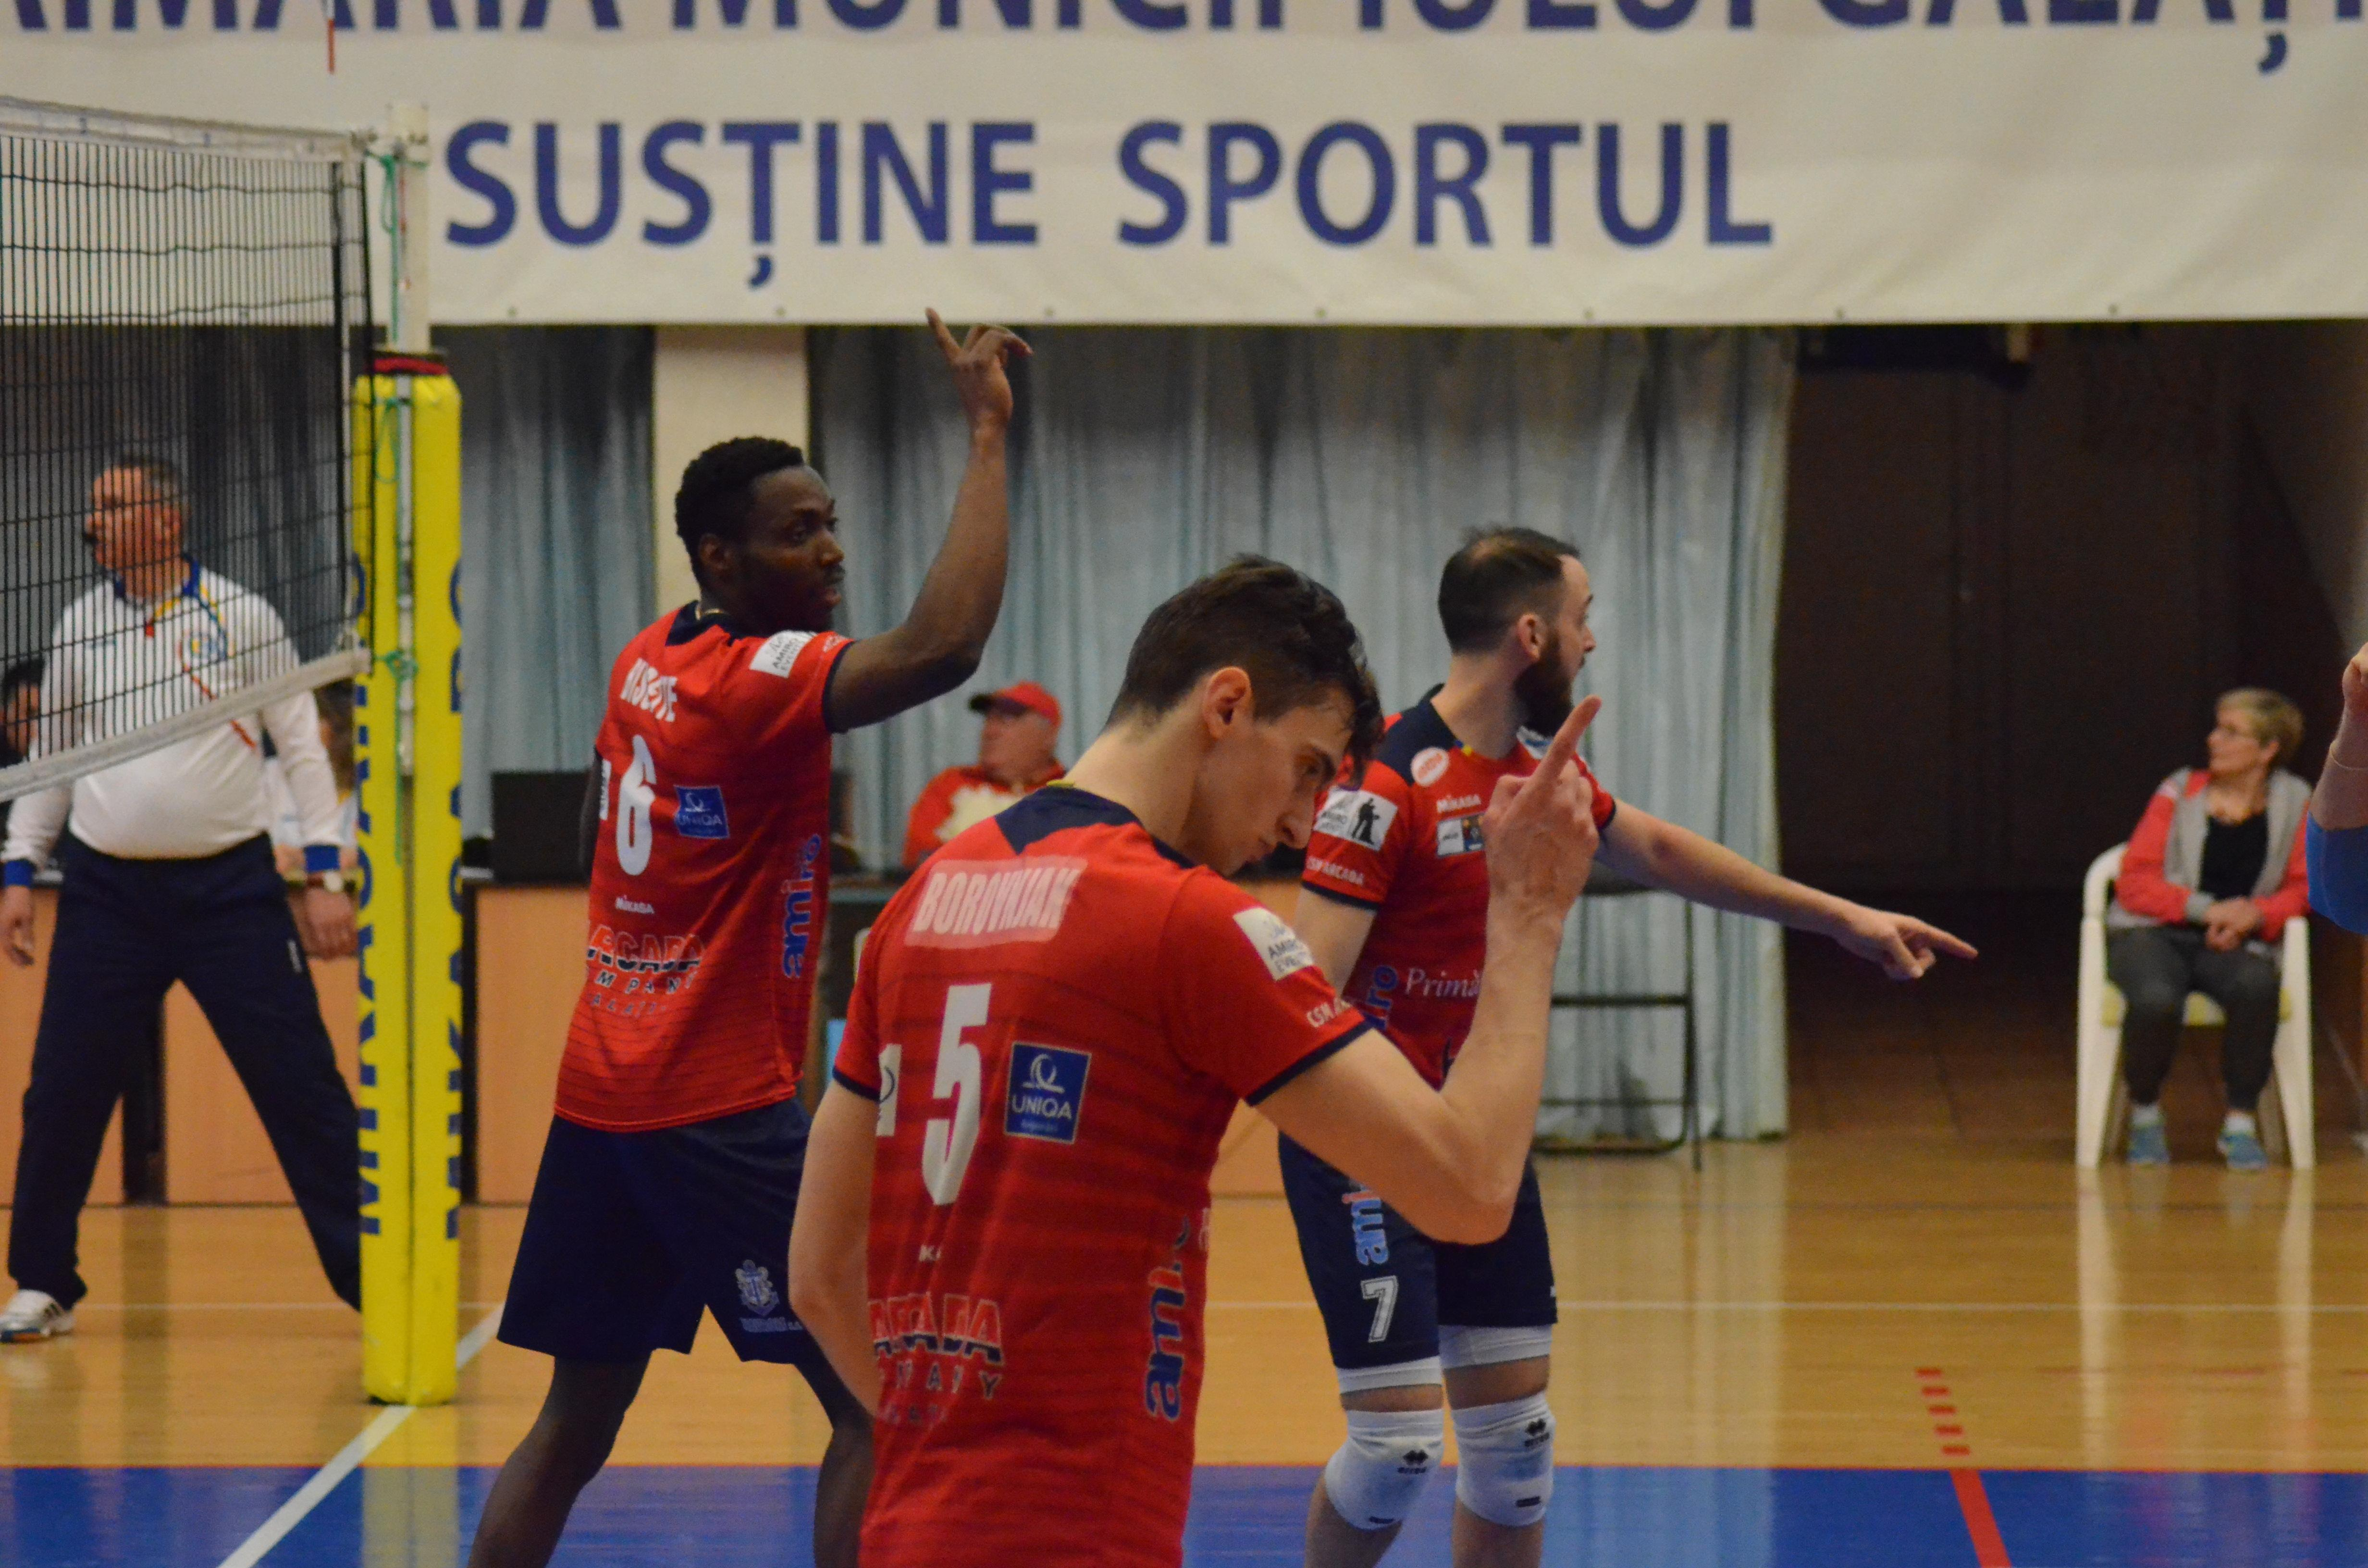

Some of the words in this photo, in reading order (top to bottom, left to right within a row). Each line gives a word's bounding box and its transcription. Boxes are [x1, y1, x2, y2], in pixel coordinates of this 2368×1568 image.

[448, 123, 1035, 287] SUSȚINE
[1121, 123, 1771, 246] SPORTUL
[616, 734, 657, 877] 6
[922, 982, 992, 1206] 5
[1011, 1095, 1073, 1120] UNIQA
[1360, 1275, 1399, 1343] 7
